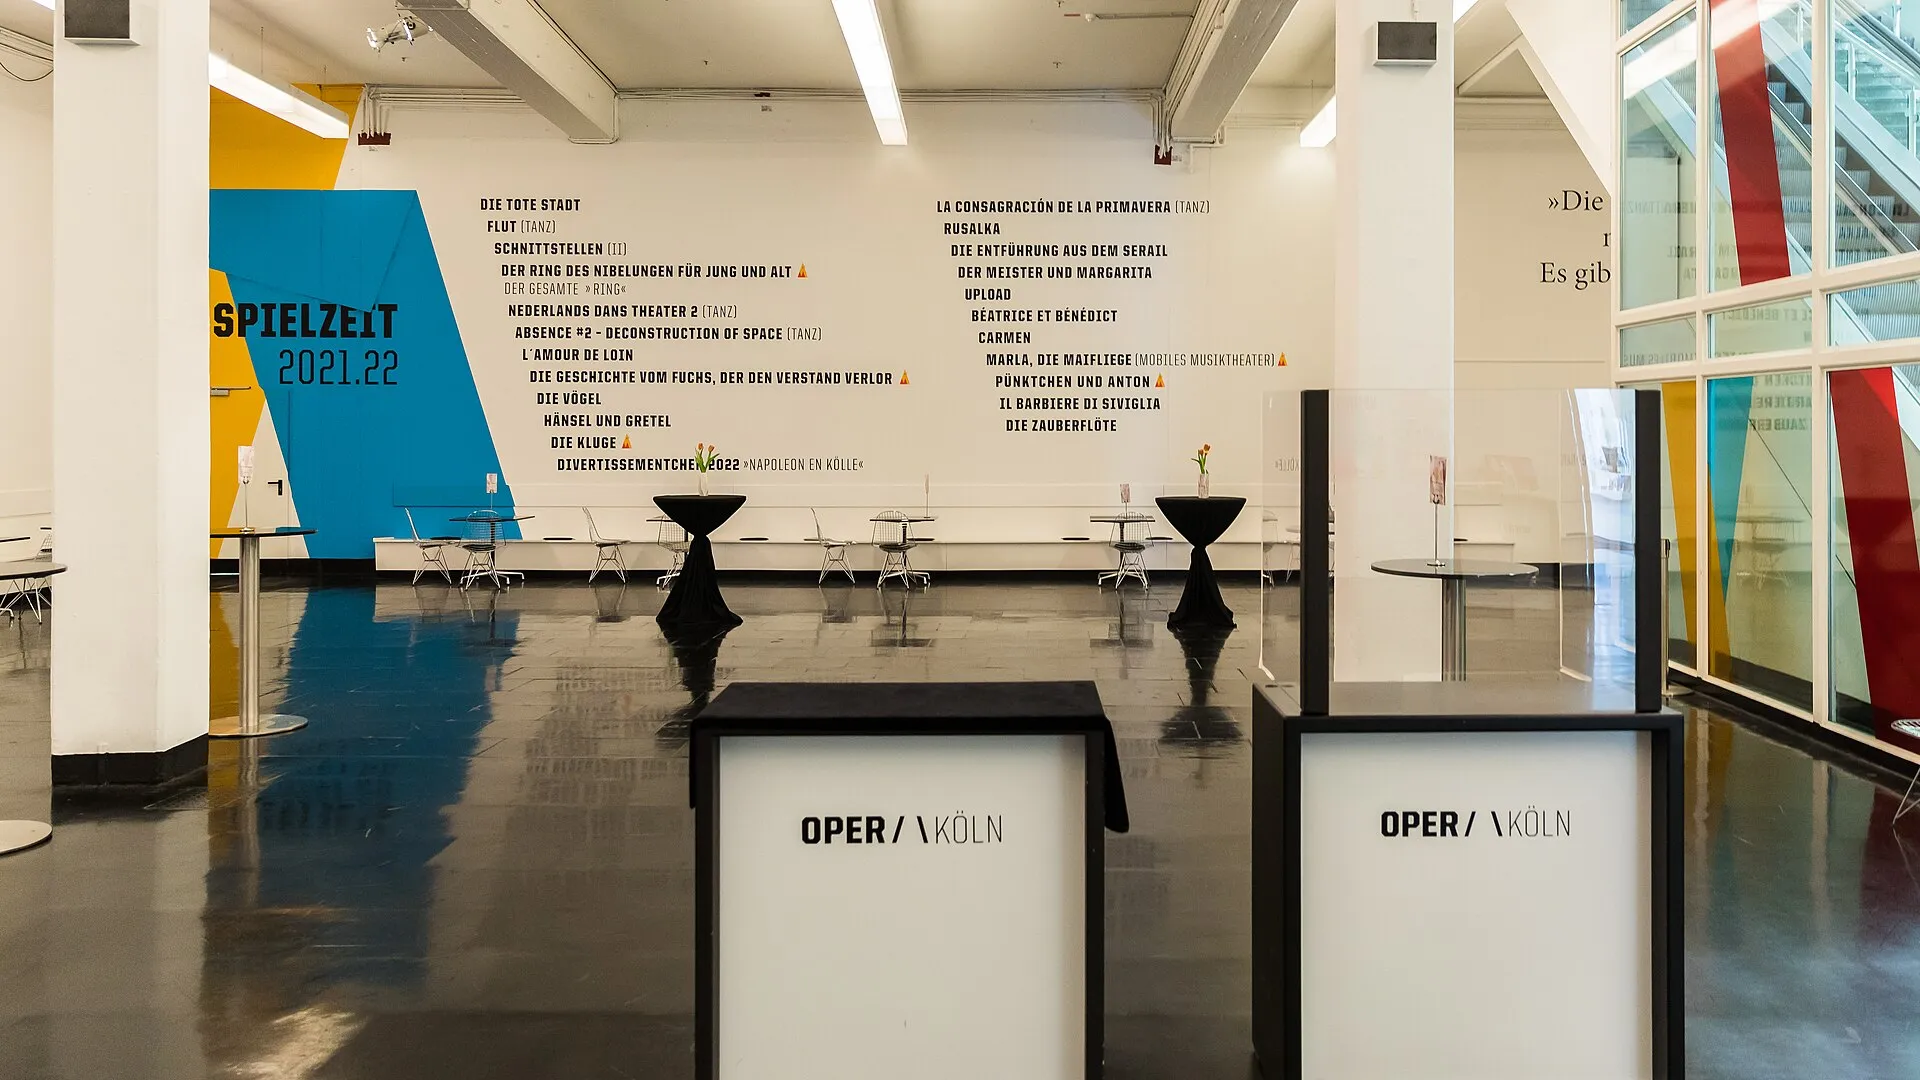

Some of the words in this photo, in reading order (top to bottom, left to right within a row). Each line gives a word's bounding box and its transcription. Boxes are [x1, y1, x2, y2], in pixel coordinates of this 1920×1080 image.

[480, 198, 503, 211] DIE
[505, 198, 537, 211] TOTE
[540, 198, 581, 212] STADT
[936, 200, 952, 213] LA
[955, 197, 1054, 214] CONSAGRACIÓN
[1057, 200, 1074, 214] DE
[1077, 200, 1092, 214] LA
[1095, 200, 1171, 214] PRIMAVERA
[487, 220, 517, 233] FLUT
[943, 222, 1001, 235] RUSALKA
[494, 242, 603, 256] SCHNITTSTELLEN
[951, 244, 973, 257] DIE
[976, 241, 1059, 257] ENTFÜHRUNG
[1062, 244, 1087, 257] AUS
[1091, 244, 1118, 257] DEM
[1122, 244, 1168, 257] SERAIL
[501, 264, 526, 277] DER
[529, 264, 562, 277] RING
[565, 264, 590, 277] DES
[593, 264, 674, 278] NIBELUNGEN
[677, 262, 702, 278] FÜR
[705, 265, 737, 278] JUNG
[741, 265, 767, 278] UND
[770, 265, 792, 278] ALT
[957, 266, 982, 279] DER
[986, 266, 1043, 279] MEISTER
[1047, 266, 1073, 279] UND
[1076, 266, 1153, 279] MARGARITA
[1540, 262, 1567, 283] Es
[504, 281, 525, 295] DER
[528, 280, 579, 296] GESAMTE
[964, 288, 1011, 301] UPLOAD
[508, 304, 590, 317] NEDERLANDS
[594, 304, 628, 318] DANS
[631, 304, 687, 318] THEATER
[690, 305, 698, 318] 2
[971, 306, 1033, 322] BÉATRICE
[1037, 309, 1052, 323] ET
[1055, 306, 1118, 323] BÉNÉDICT
[213, 303, 398, 338] SPIELZEIT
[514, 326, 572, 339] ABSENCE
[576, 326, 592, 340] #2
[605, 326, 720, 340] DECONSTRUCTION
[723, 327, 739, 340] OF
[742, 327, 783, 340] SPACE
[978, 331, 1031, 344] CARMEN
[583, 348, 599, 361] DE
[603, 348, 634, 362] LOIN
[986, 353, 1033, 368] MARLA,
[1037, 353, 1059, 366] DIE
[1063, 353, 1132, 366] MAIFLIEGE
[279, 349, 398, 385] 2021.22
[529, 370, 552, 383] DIE
[556, 370, 636, 384] GESCHICHTE
[639, 370, 668, 384] VOM
[671, 371, 716, 386] FUCHS,
[720, 371, 744, 384] DER
[748, 371, 772, 384] DEN
[776, 371, 841, 385] VERSTAND
[844, 372, 893, 385] VERLOR
[995, 372, 1072, 388] PÜNKTCHEN
[1077, 375, 1103, 388] UND
[1107, 375, 1150, 388] ANTON
[536, 392, 559, 405] DIE
[562, 389, 602, 405] VÖGEL
[999, 397, 1013, 410] IL
[1016, 397, 1080, 410] BARBIERE
[1083, 397, 1098, 410] DI
[1101, 397, 1161, 410] SIVIGLIA
[543, 411, 592, 427] HÄNSEL
[595, 414, 621, 427] UND
[625, 414, 672, 428] GRETEL
[1005, 419, 1028, 432] DIE
[1031, 416, 1117, 432] ZAUBERFLÖTE
[550, 436, 573, 449] DIE
[577, 436, 617, 449] KLUGE
[809, 457, 822, 471] EN
